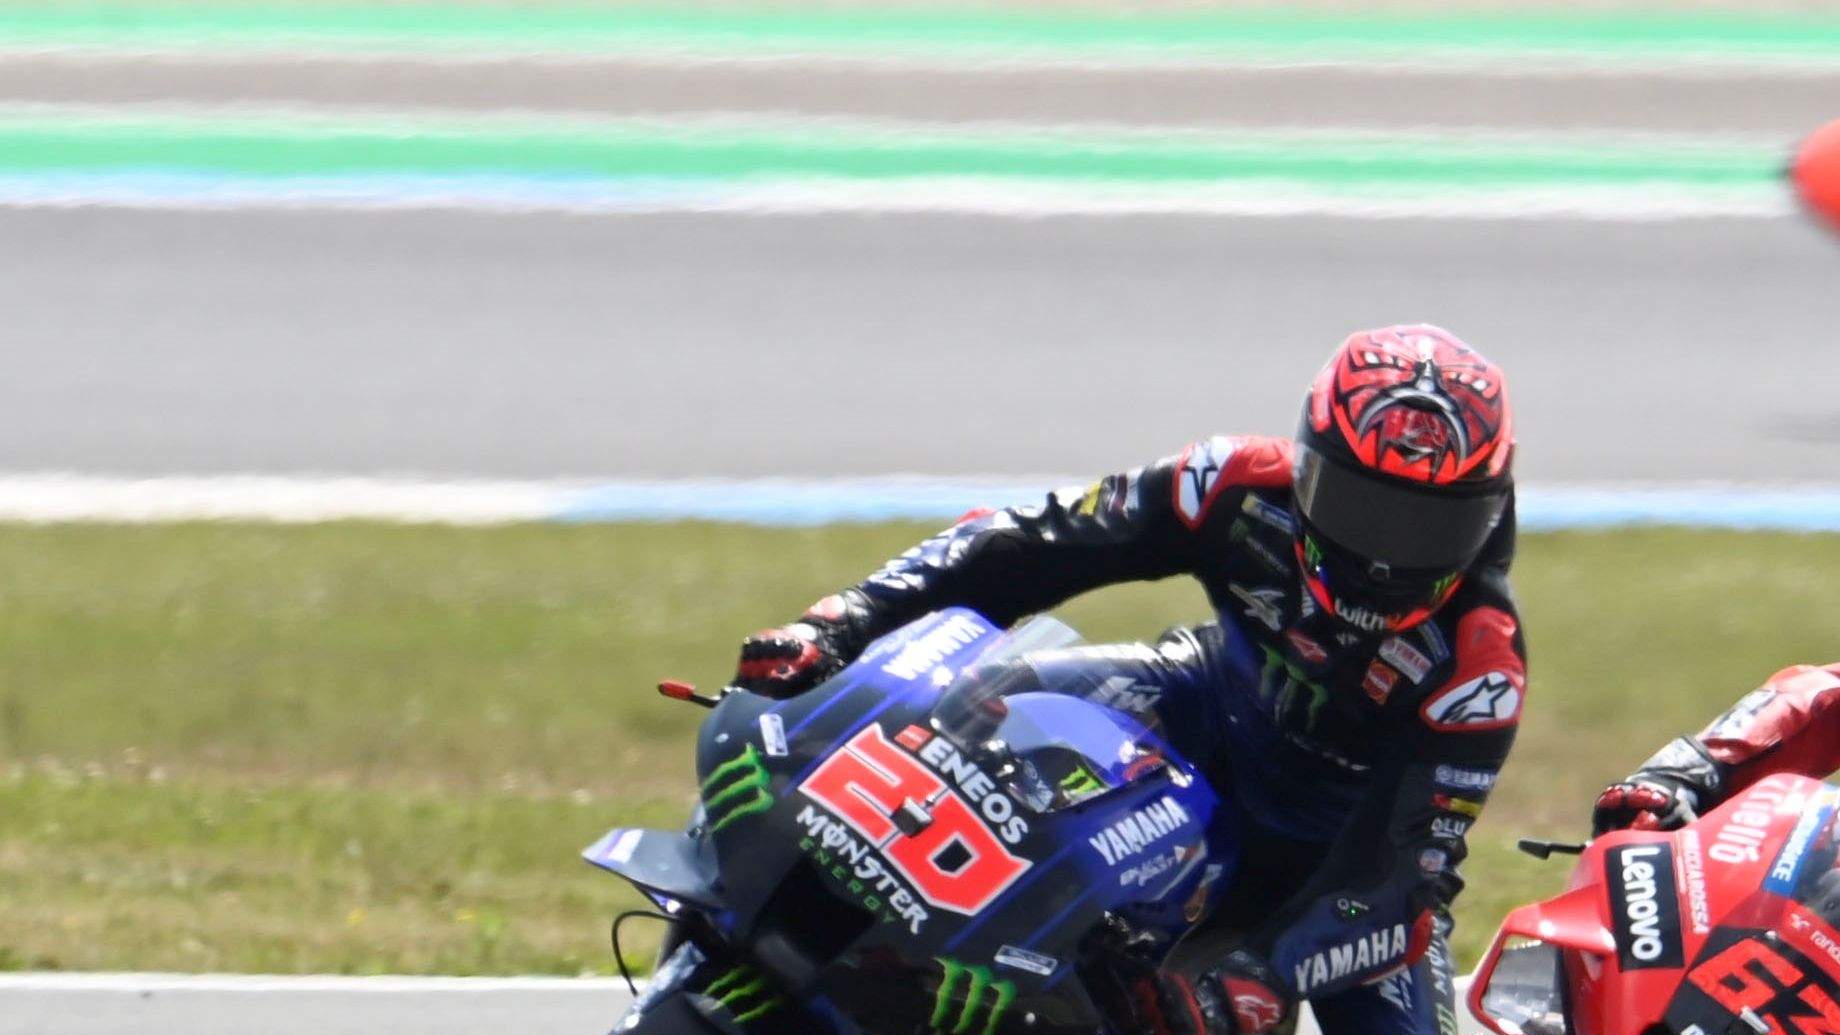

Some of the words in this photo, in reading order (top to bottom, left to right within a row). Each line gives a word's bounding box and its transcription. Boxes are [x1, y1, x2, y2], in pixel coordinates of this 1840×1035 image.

[797, 721, 1034, 917] 20
[919, 736, 1030, 844] ENEOS
[1089, 795, 1190, 867] YAMAHA
[796, 805, 929, 935] MONSTER
[799, 836, 896, 924] ENERGY
[1621, 847, 1663, 960] Lenovo
[1294, 923, 1407, 993] YAMAHA
